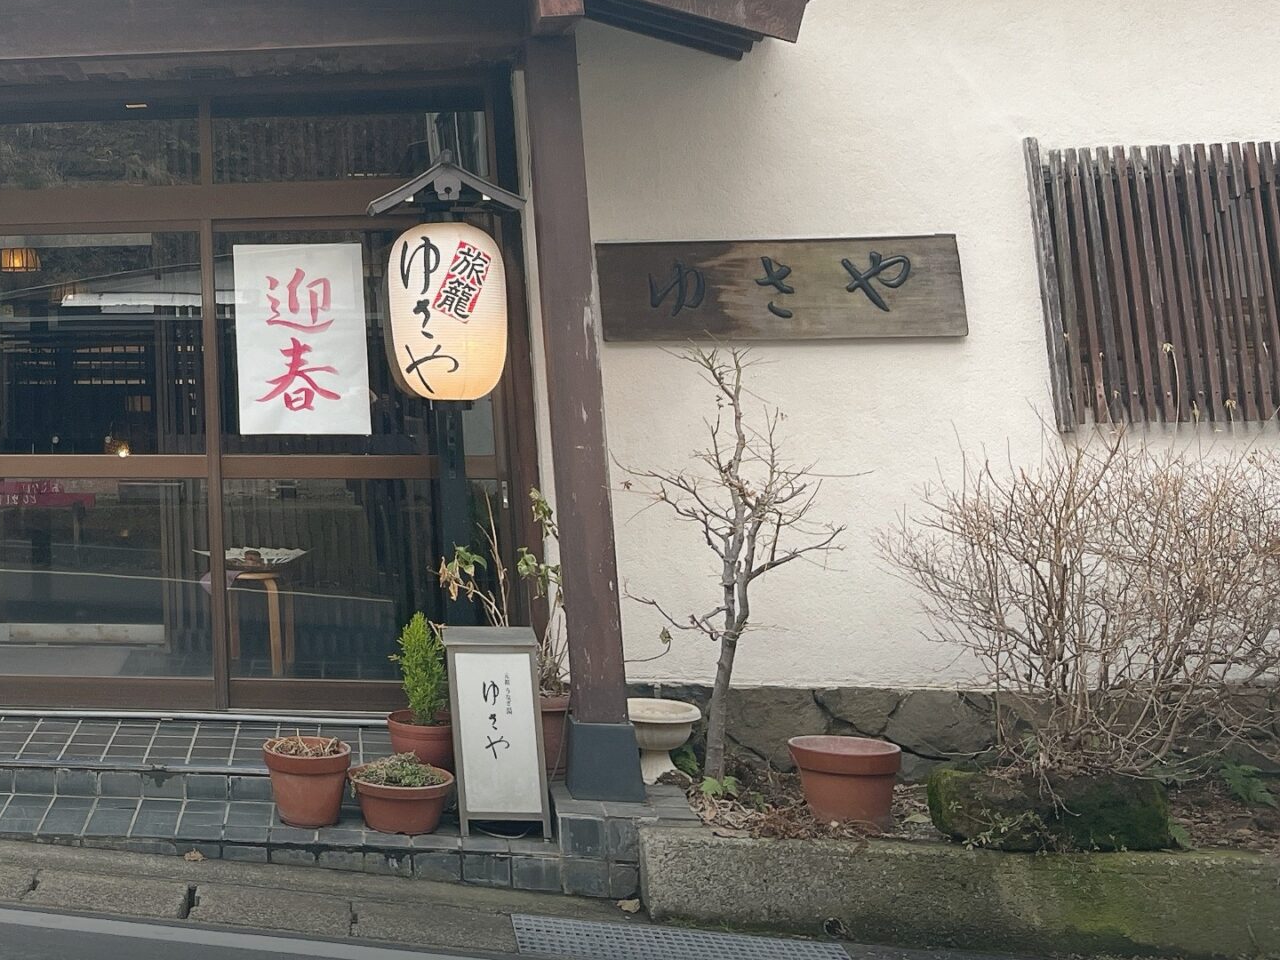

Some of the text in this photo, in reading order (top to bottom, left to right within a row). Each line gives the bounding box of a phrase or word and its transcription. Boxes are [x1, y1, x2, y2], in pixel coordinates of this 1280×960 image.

[400, 236, 460, 395] ゆさや
[434, 244, 487, 322] 旅籠
[647, 250, 911, 319] ゆさや
[255, 267, 342, 412] 迎春
[482, 680, 510, 760] ゆさや
